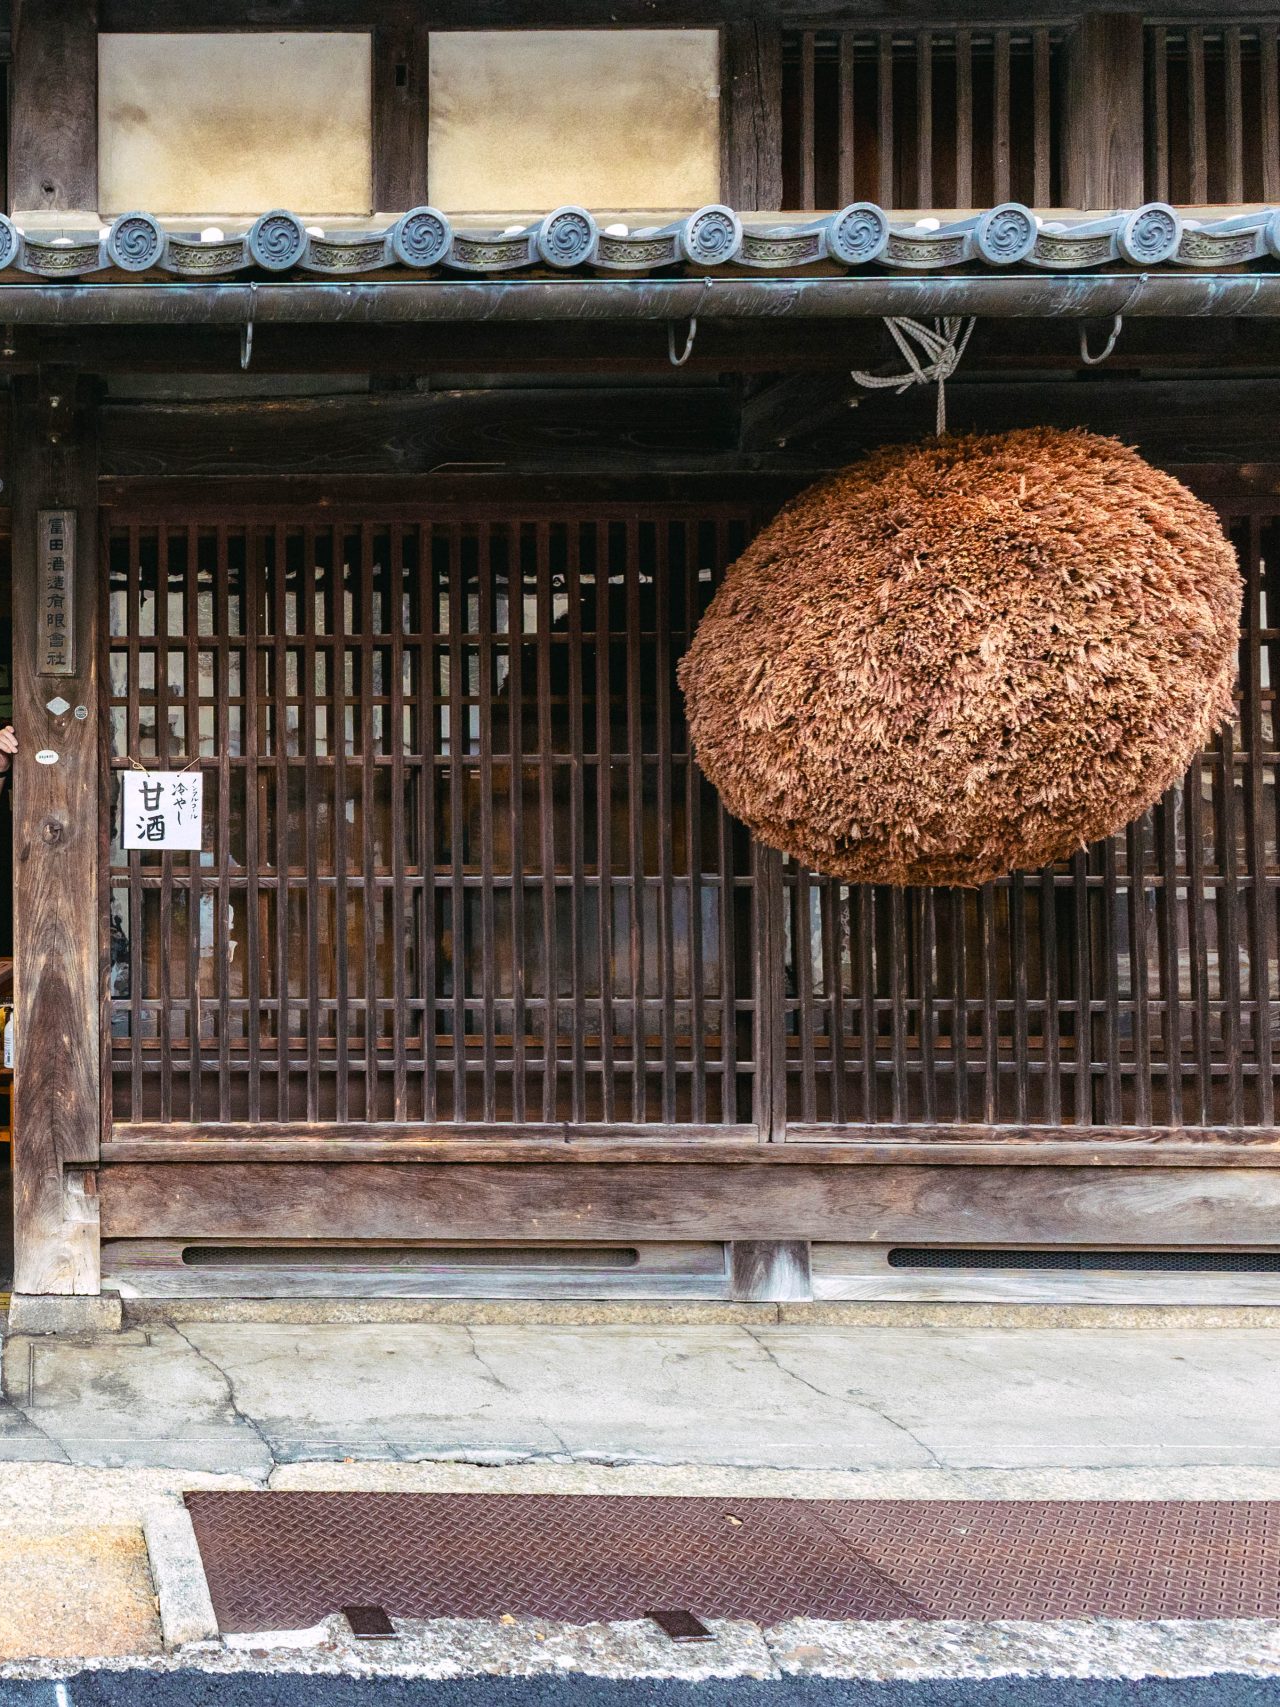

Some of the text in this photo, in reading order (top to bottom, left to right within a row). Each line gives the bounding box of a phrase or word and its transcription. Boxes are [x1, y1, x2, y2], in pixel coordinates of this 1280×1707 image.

[136, 780, 165, 842] 甘酒
[171, 782, 189, 826] 冷やし
